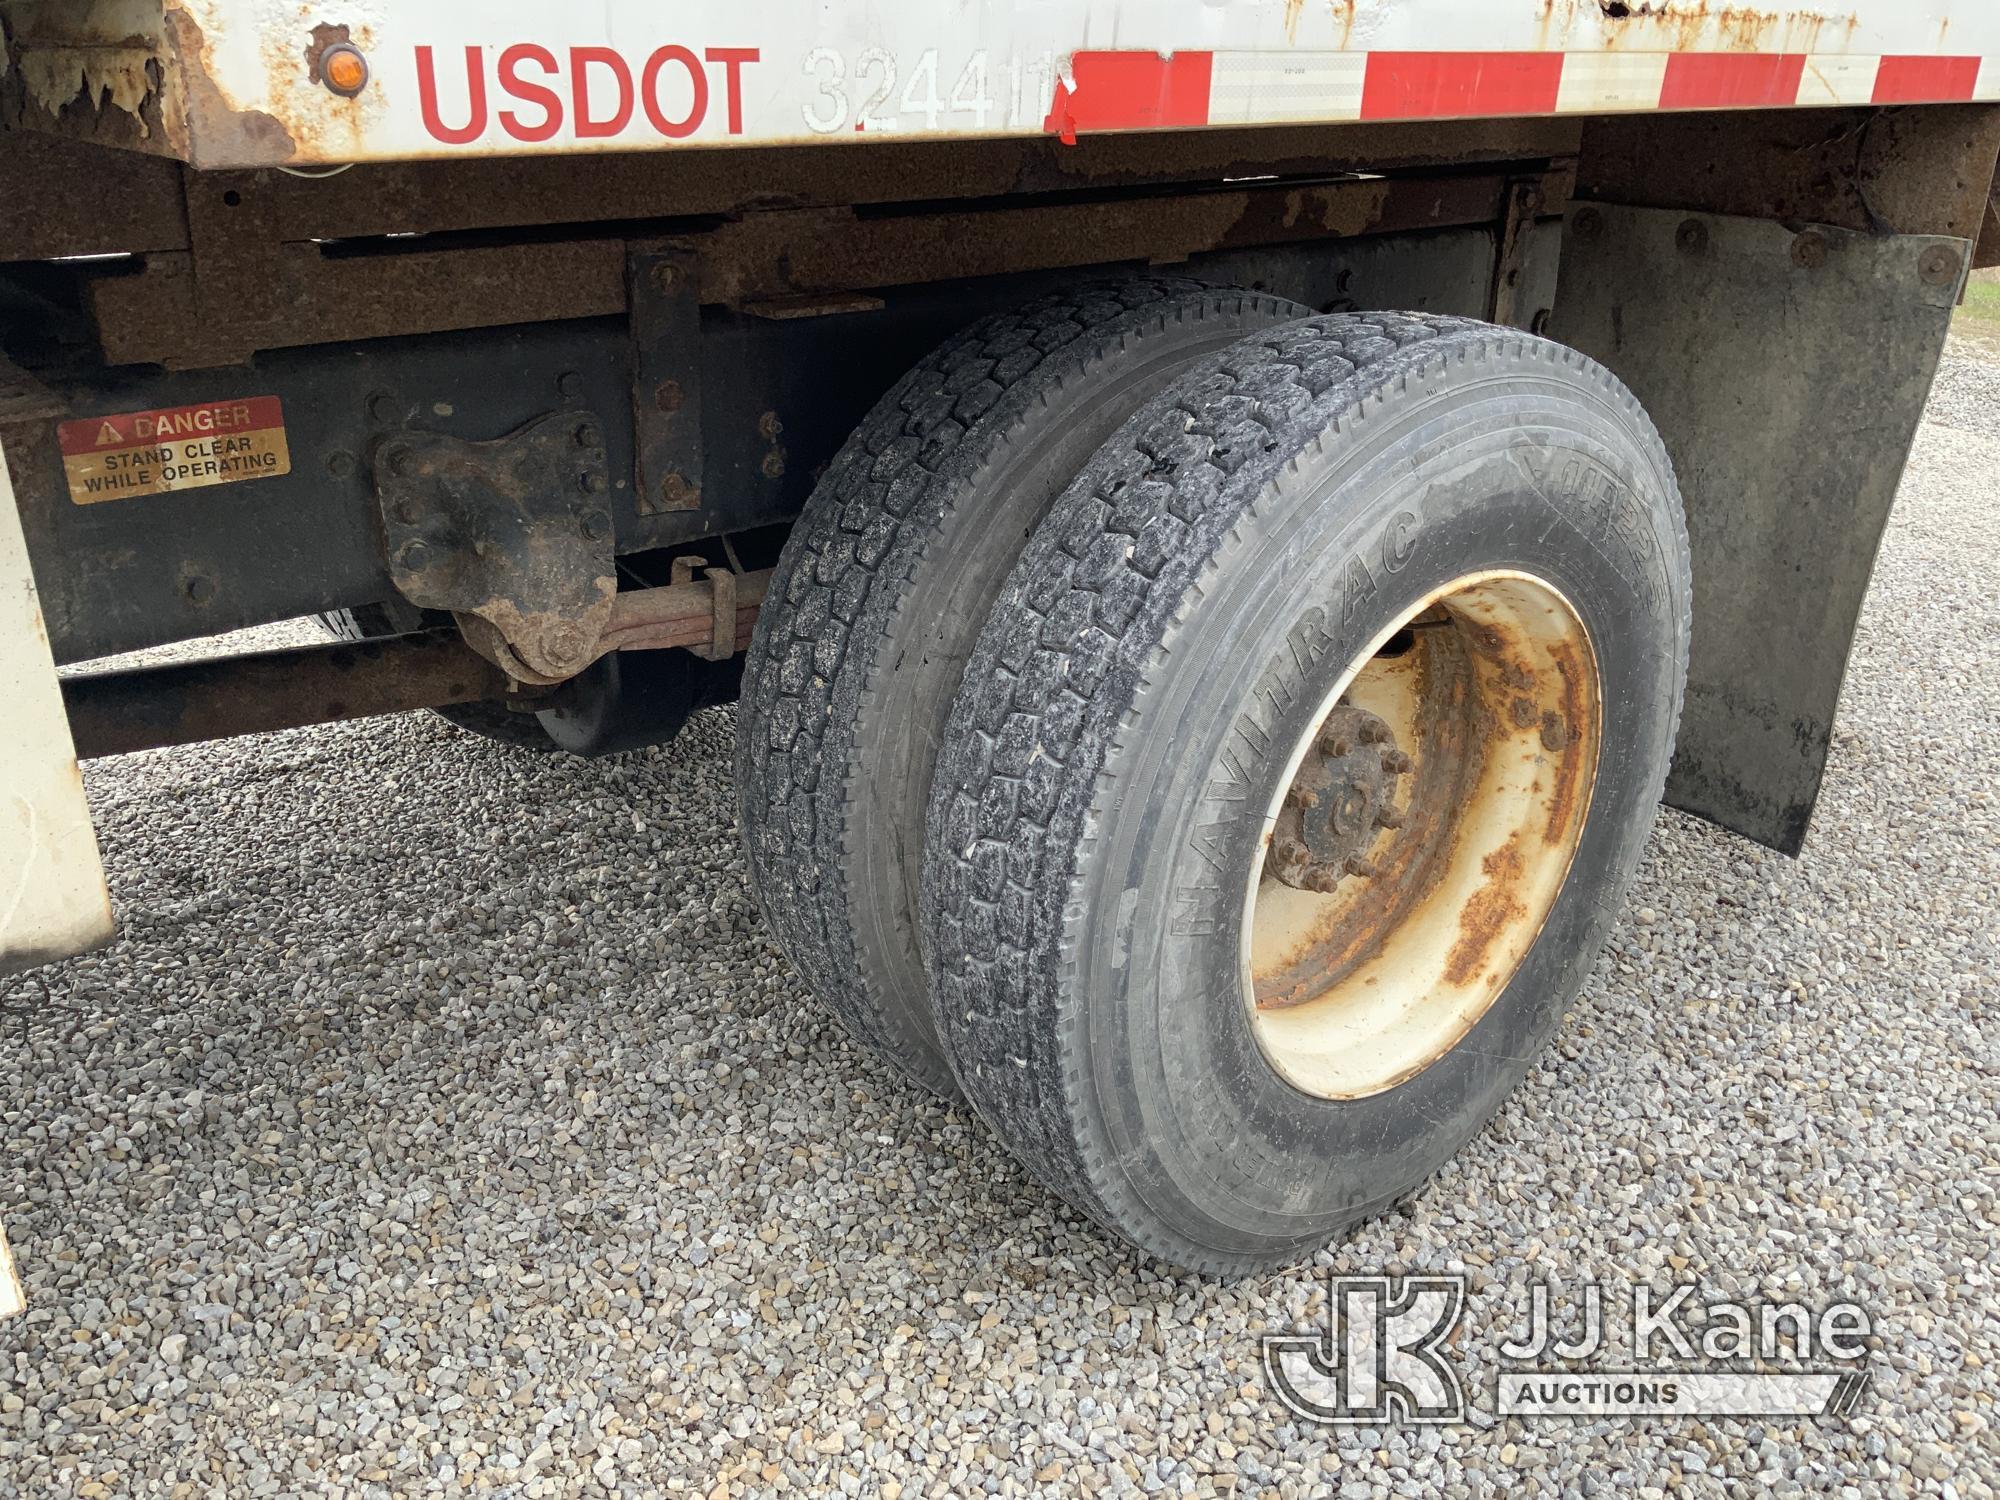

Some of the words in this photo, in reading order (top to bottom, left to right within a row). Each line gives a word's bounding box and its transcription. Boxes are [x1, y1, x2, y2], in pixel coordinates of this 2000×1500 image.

[414, 43, 761, 145] USDOT
[134, 405, 251, 438] DANGER
[83, 469, 152, 494] WHILE
[162, 451, 278, 482] OPERATING
[104, 447, 174, 471] STAND
[184, 436, 253, 460] CLEAR
[1171, 510, 1421, 937] NAVITRAC
